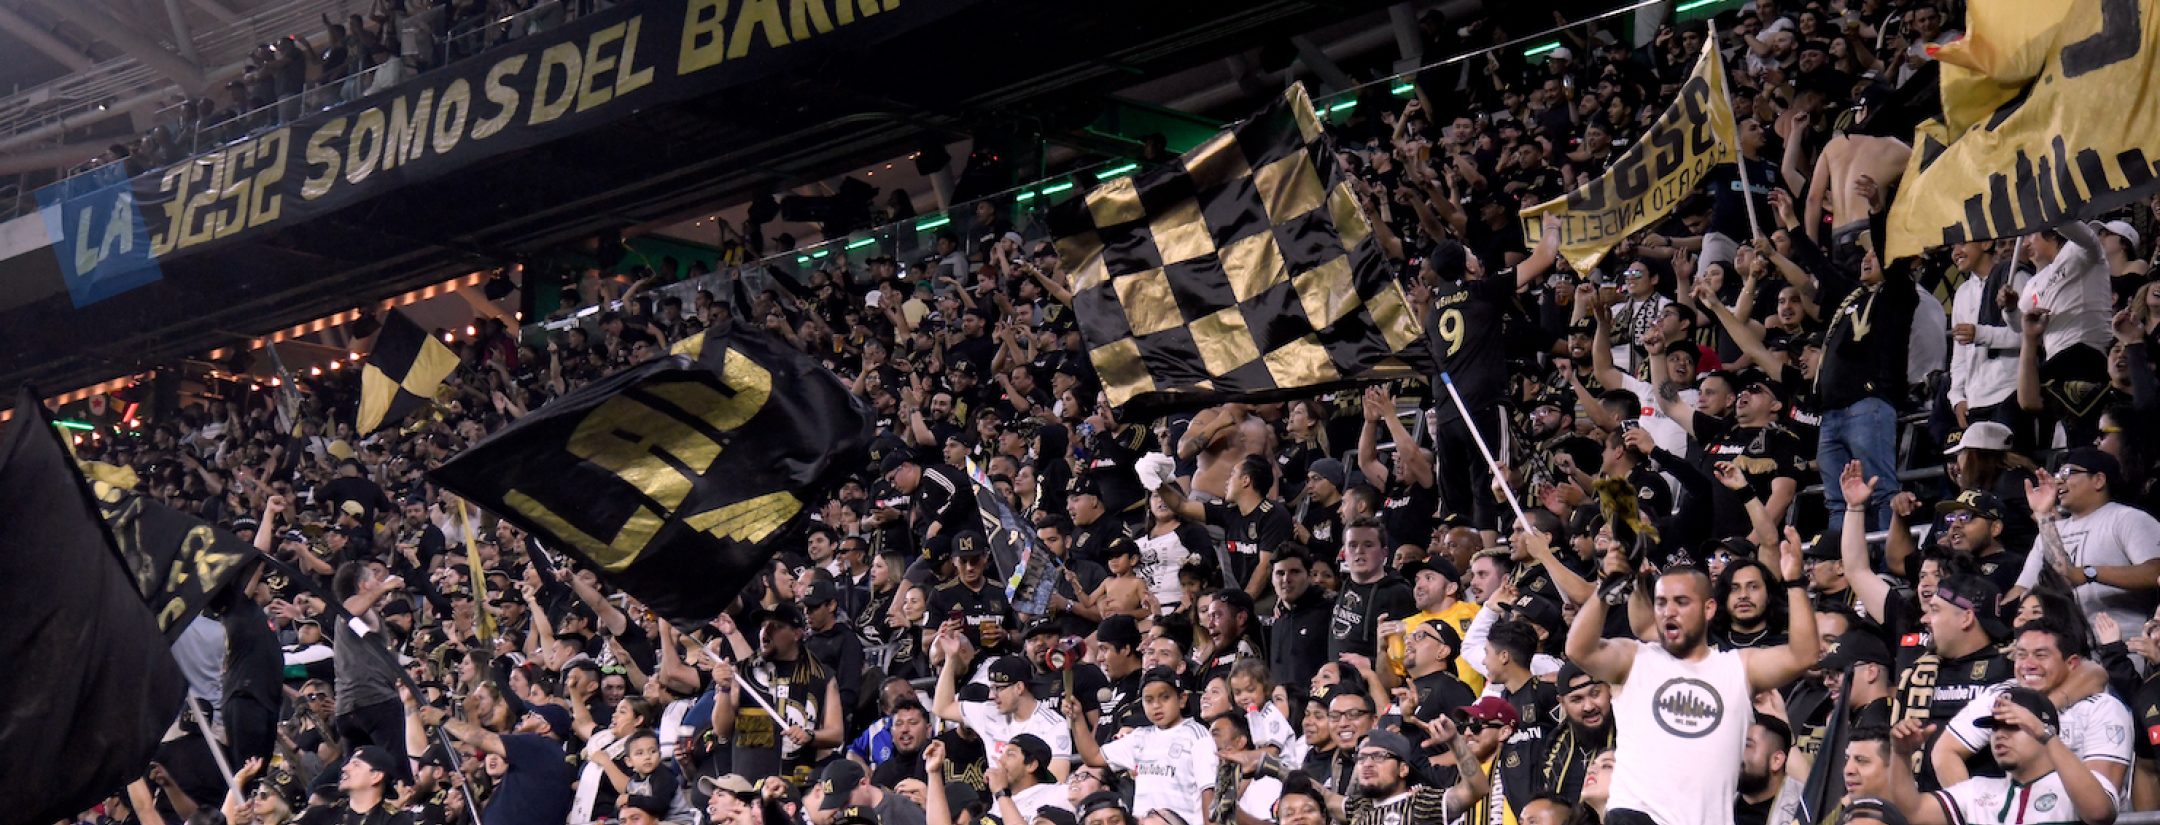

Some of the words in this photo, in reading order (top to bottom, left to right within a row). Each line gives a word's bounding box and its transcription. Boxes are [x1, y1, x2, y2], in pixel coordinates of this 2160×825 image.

[75, 190, 133, 277] LA
[148, 126, 291, 259] 3252
[301, 52, 528, 200] SOMOS
[528, 14, 655, 126] DEL
[677, 0, 901, 75] BAR
[1438, 308, 1465, 358] 9
[1933, 685, 1968, 702] YouTube
[1138, 763, 1166, 777] YouTube
